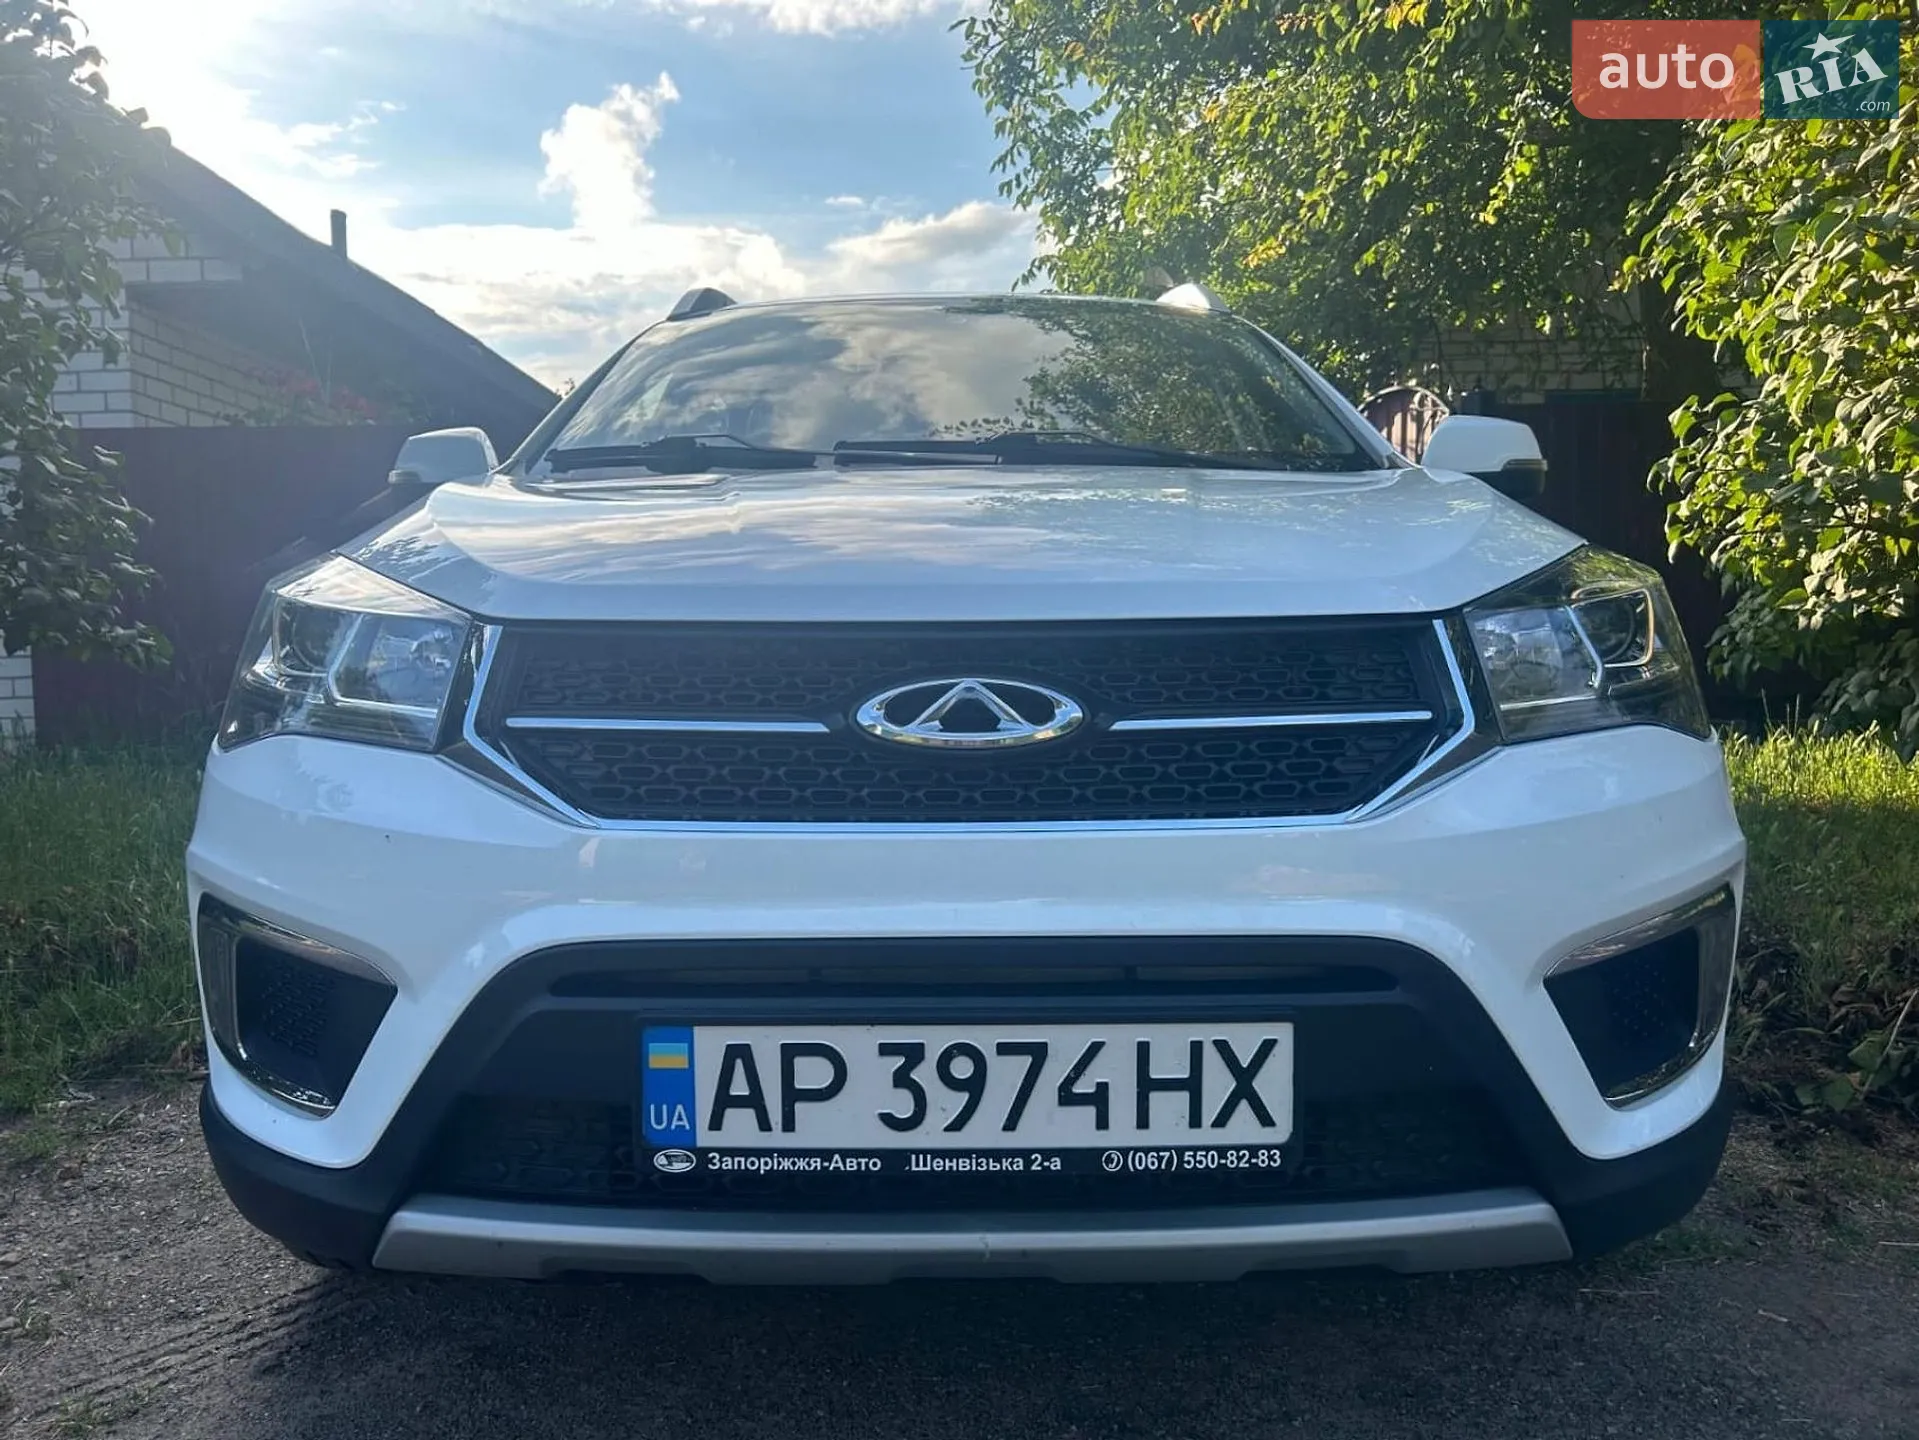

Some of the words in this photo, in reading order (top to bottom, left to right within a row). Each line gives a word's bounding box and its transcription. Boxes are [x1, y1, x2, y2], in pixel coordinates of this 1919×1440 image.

[707, 1042, 848, 1132] AP
[877, 1040, 1110, 1132] 3974
[1135, 1037, 1279, 1131] HX
[650, 1104, 690, 1130] UA
[707, 1152, 882, 1175] Запоріжжя-Авто
[911, 1153, 1024, 1171] Шенвізька
[1030, 1153, 1062, 1171] 2-а
[1127, 1150, 1178, 1172] (067)
[1183, 1149, 1281, 1169] 550-82-83
